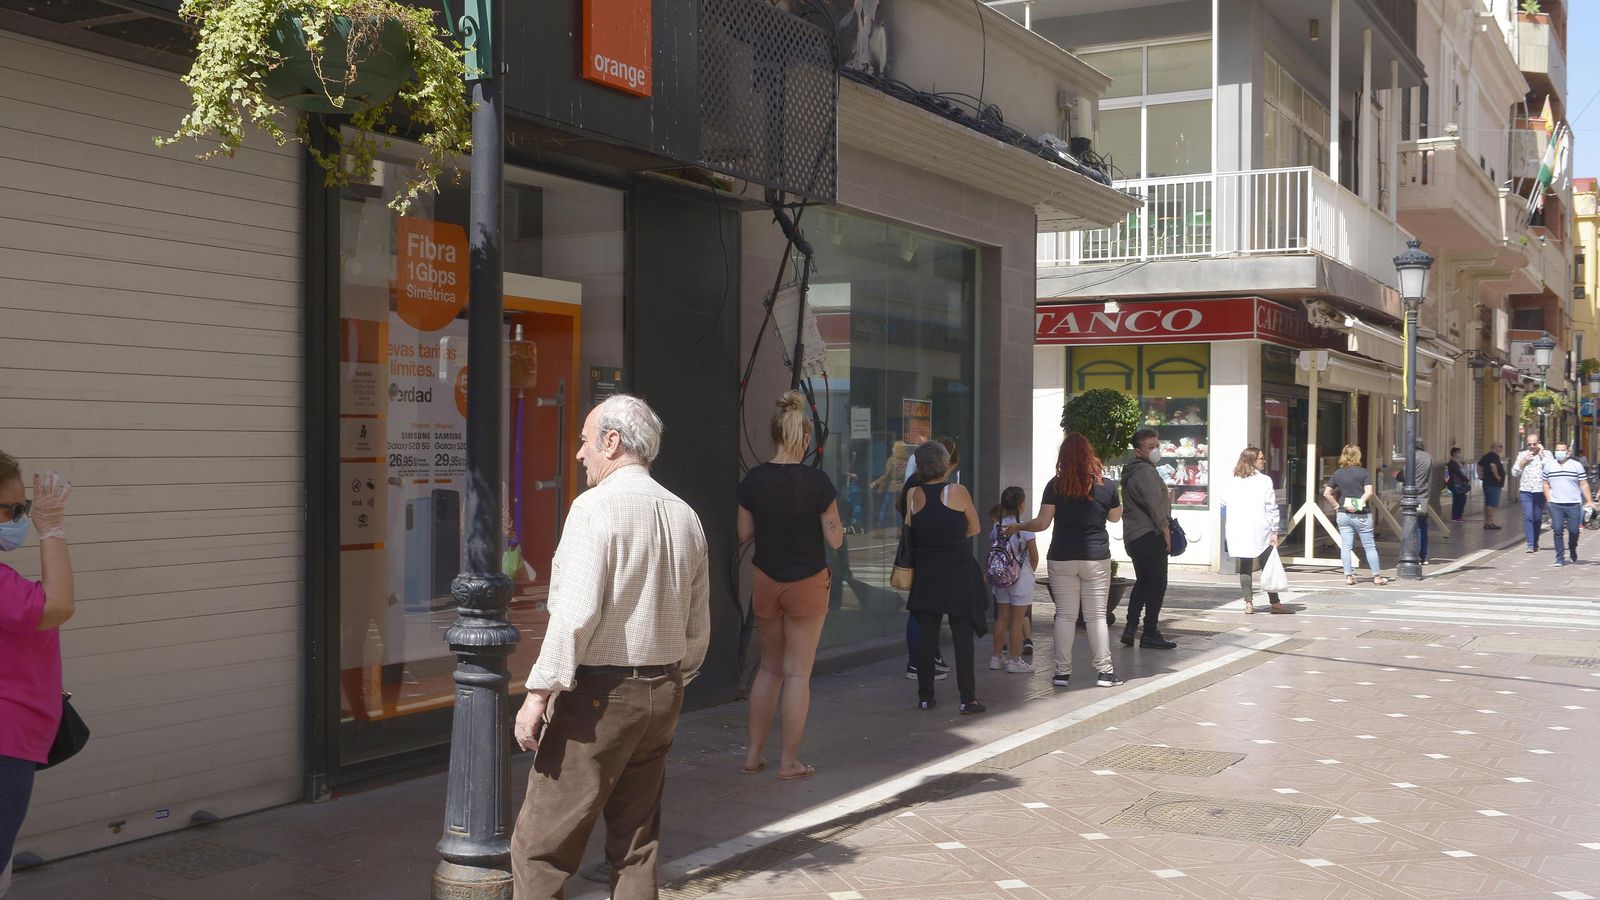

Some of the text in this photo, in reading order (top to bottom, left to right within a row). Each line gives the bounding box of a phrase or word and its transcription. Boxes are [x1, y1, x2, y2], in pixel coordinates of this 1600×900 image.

[594, 54, 646, 88] orange
[407, 232, 456, 263] Fibra
[407, 261, 456, 288] 1Gbps
[406, 283, 456, 303] Simétrica
[1036, 308, 1203, 335] TANCO
[389, 386, 432, 403] erdad
[401, 432, 430, 440] SAMSUNG
[408, 442, 420, 450] S20
[434, 432, 462, 440] SAMSUNG
